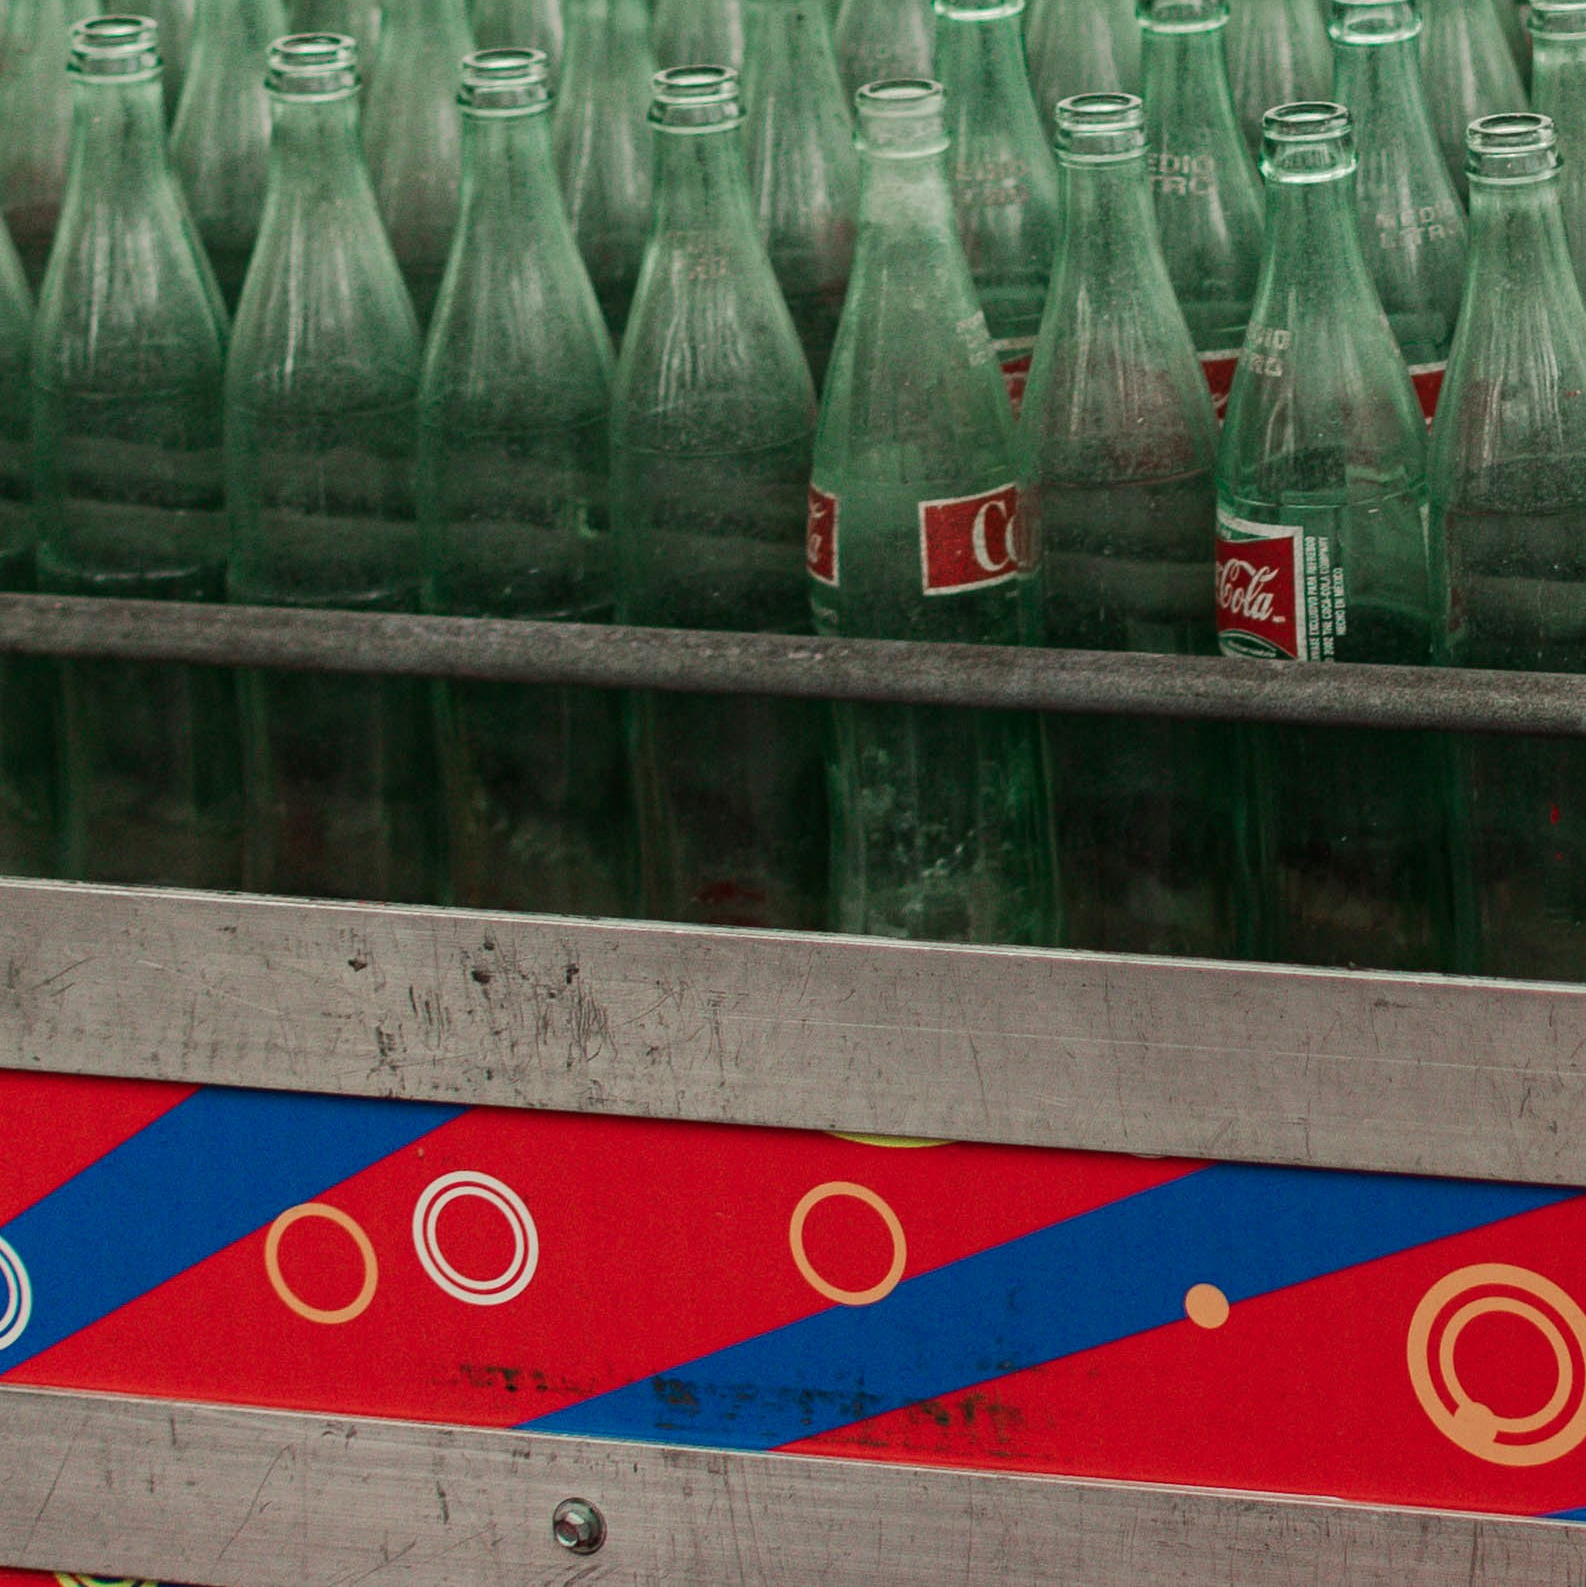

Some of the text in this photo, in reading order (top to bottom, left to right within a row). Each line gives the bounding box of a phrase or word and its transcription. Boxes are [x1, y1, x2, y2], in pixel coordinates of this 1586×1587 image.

[1146, 152, 1215, 175] EDIO
[1318, 536, 1331, 574] COMPANY
[1306, 576, 1318, 595] PARA
[1320, 575, 1333, 620] COCA-COLA
[1334, 597, 1346, 609] EN
[1321, 620, 1333, 636] THE
[1335, 609, 1347, 636] HECHO
